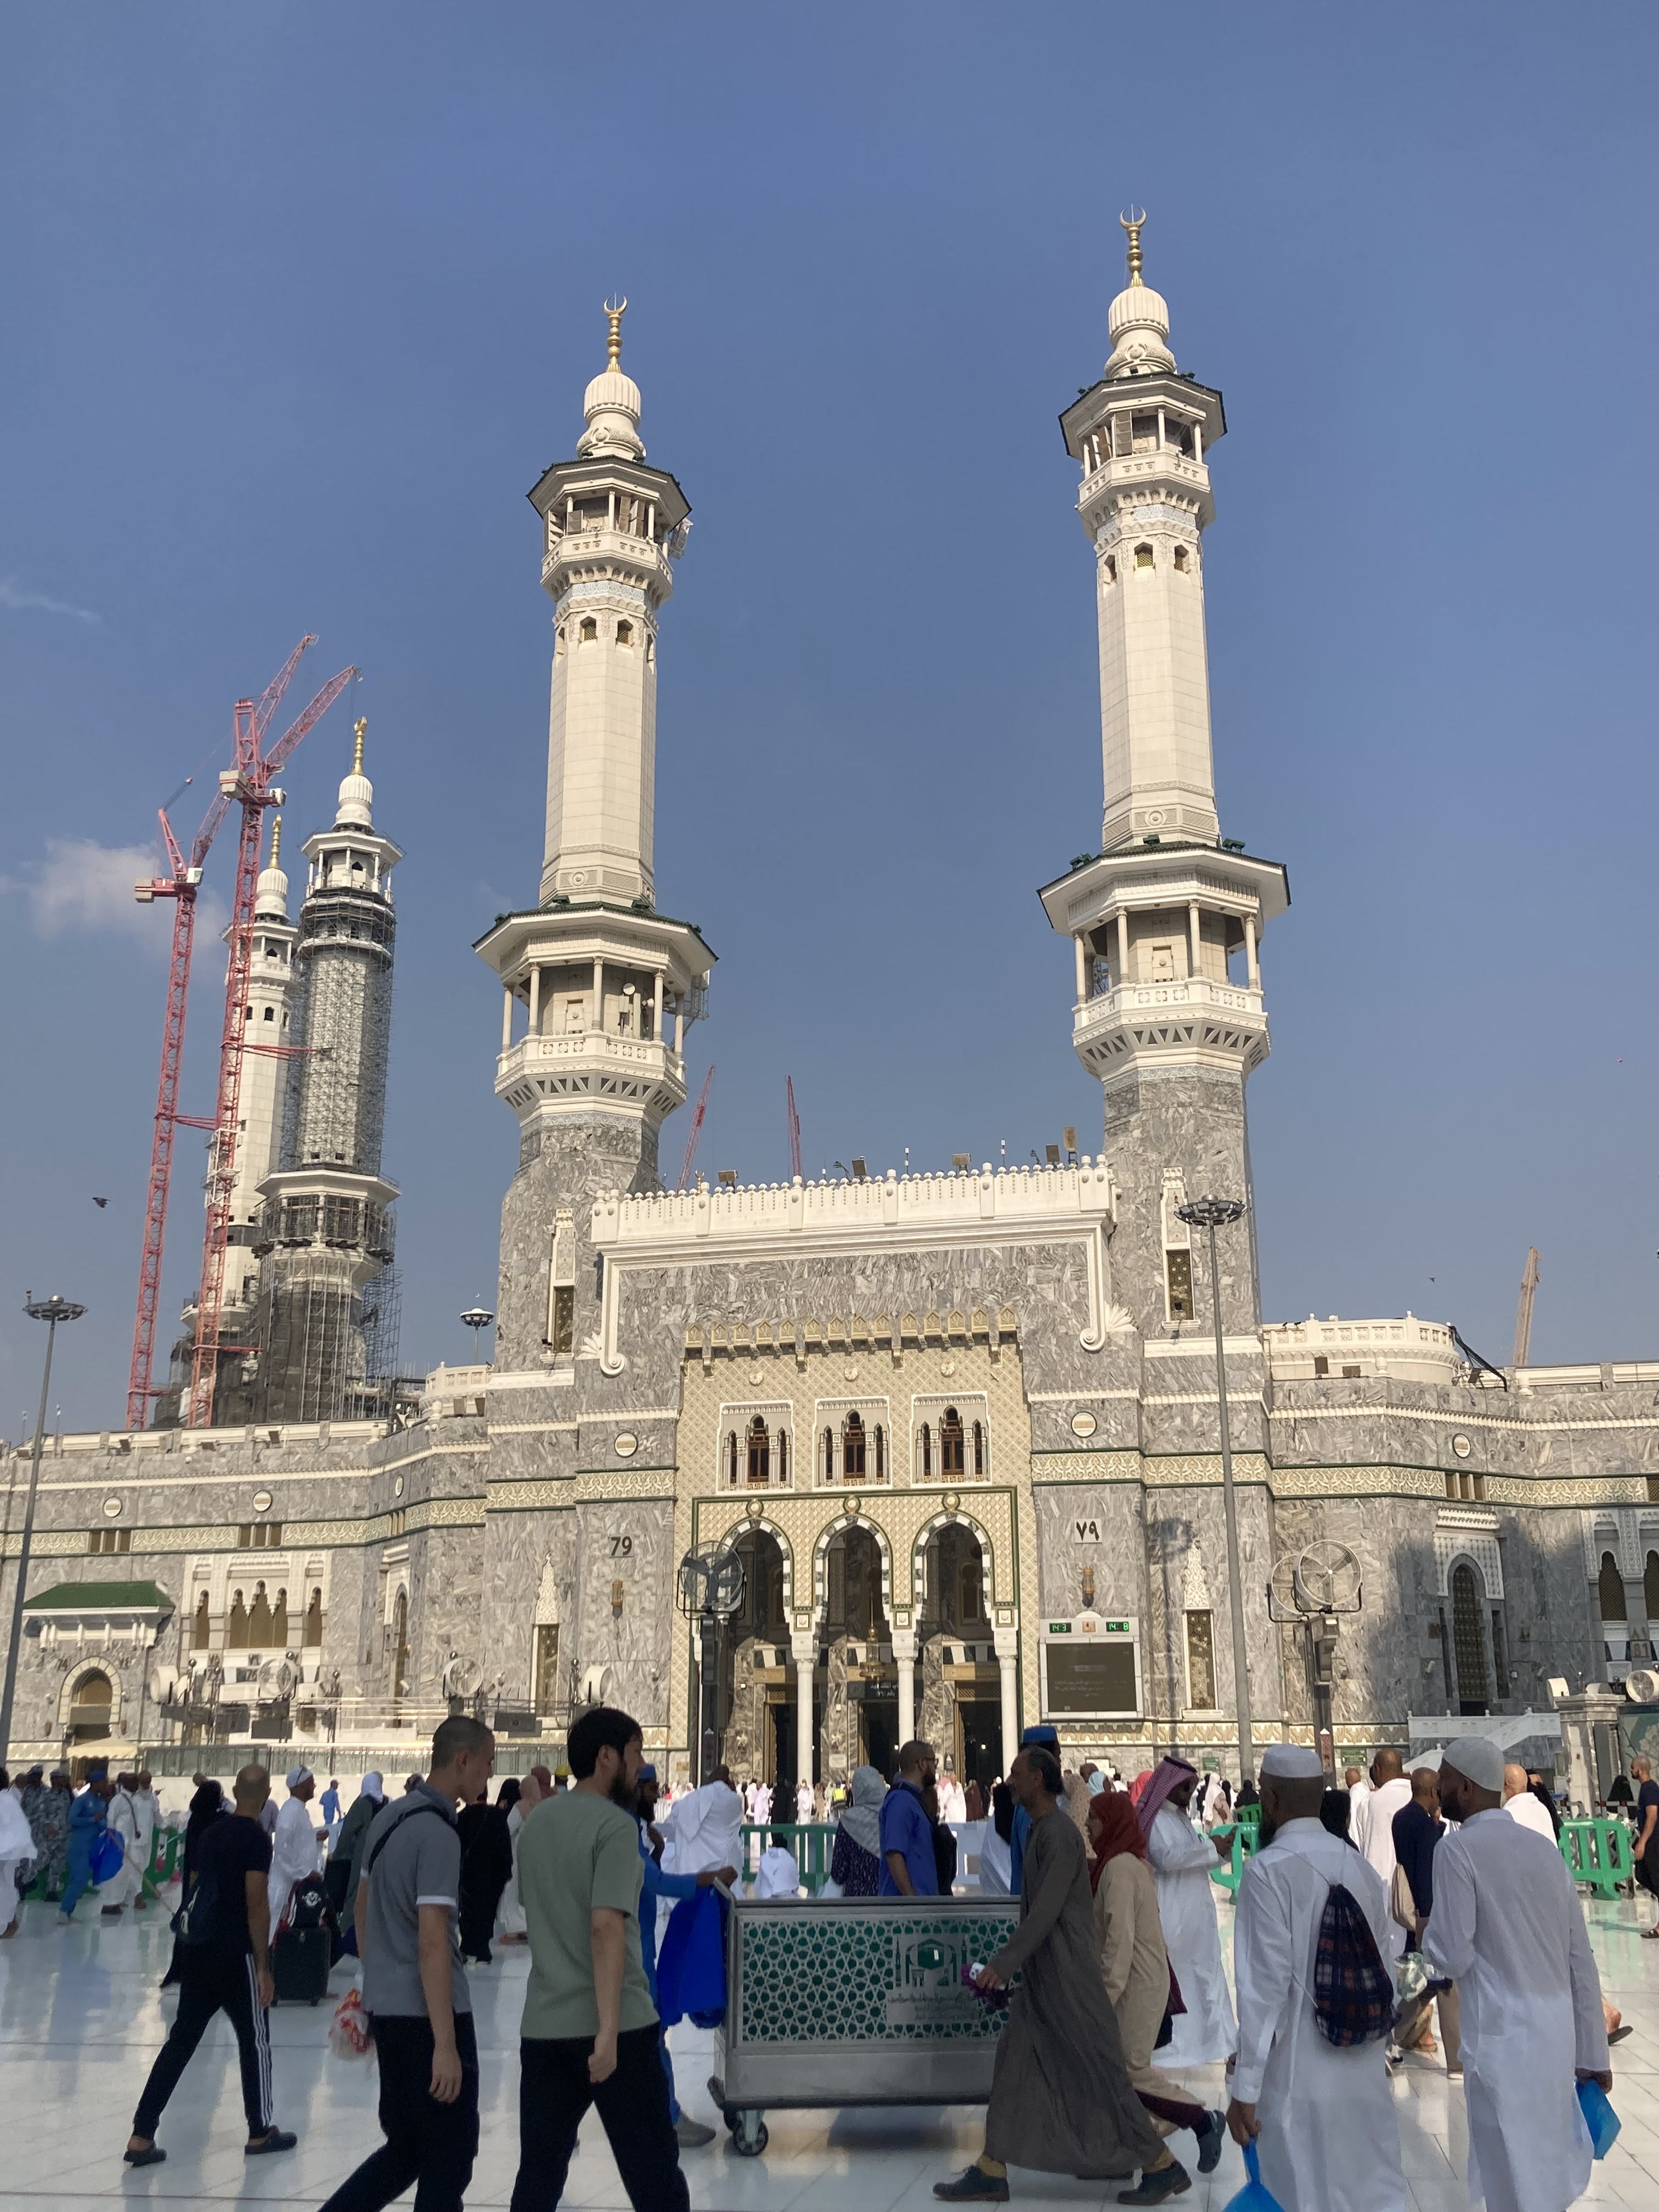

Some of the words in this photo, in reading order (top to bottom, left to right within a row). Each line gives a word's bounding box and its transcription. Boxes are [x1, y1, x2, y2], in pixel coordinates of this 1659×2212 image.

[1076, 1521, 1099, 1541] ٧٩
[611, 1536, 632, 1556] 79
[57, 1658, 69, 1671] 74
